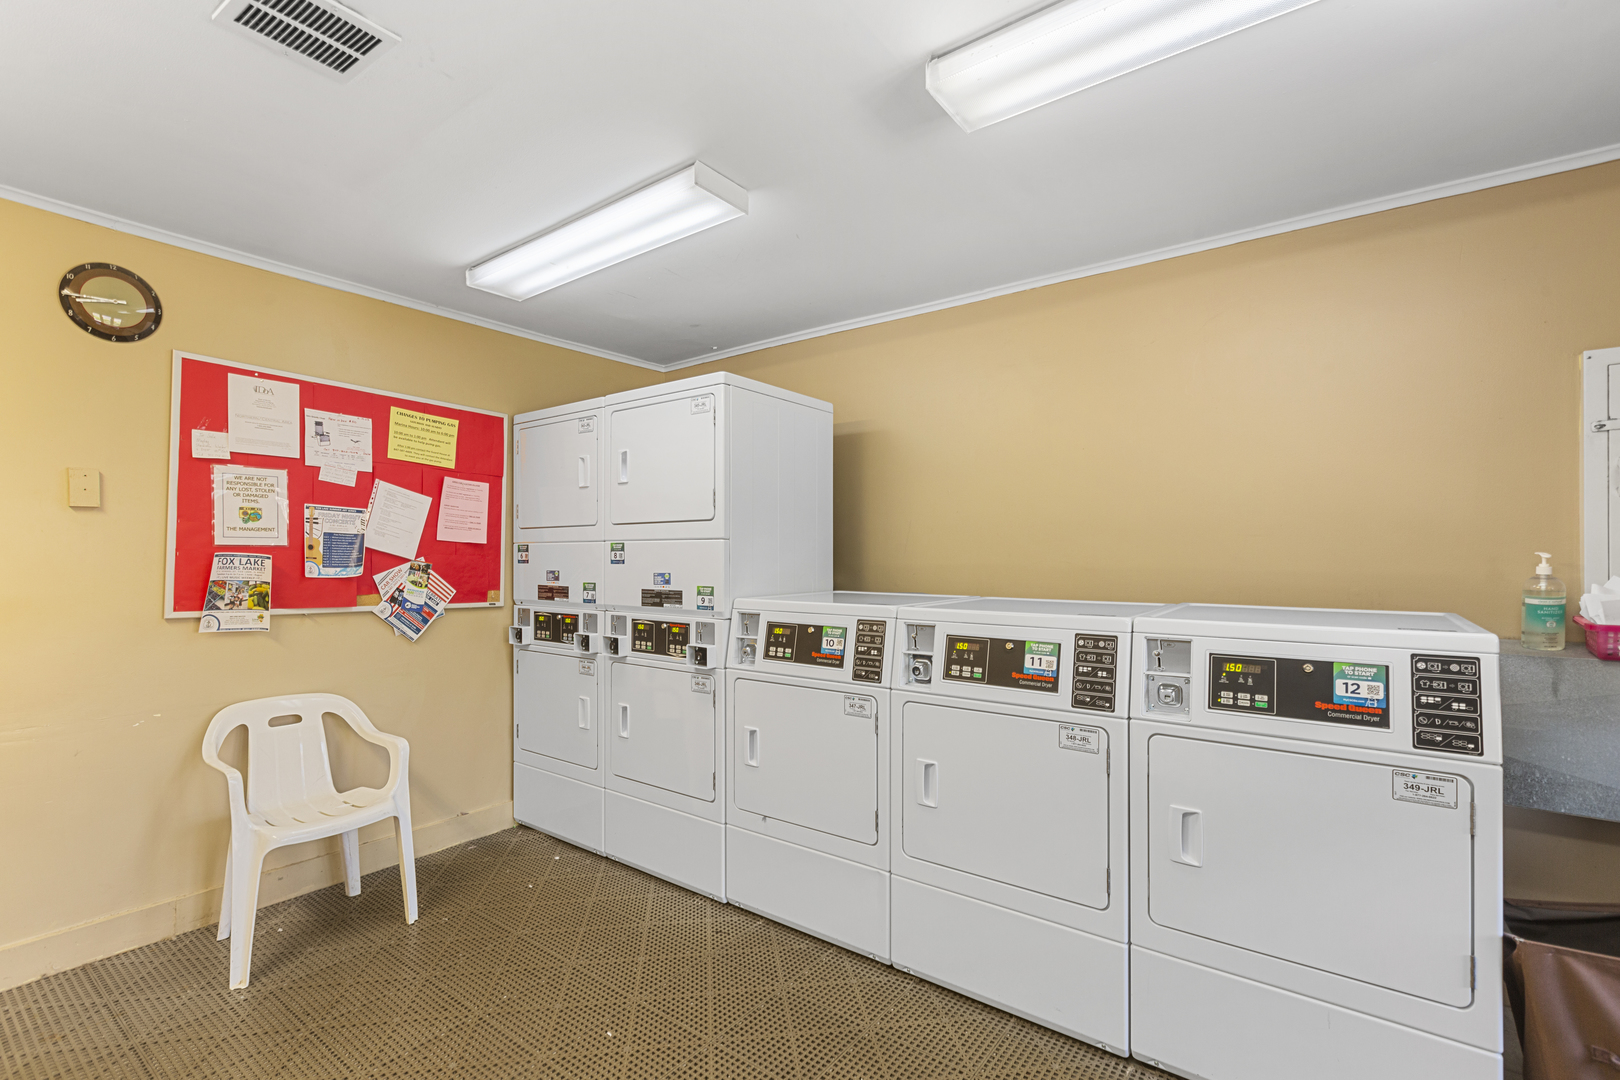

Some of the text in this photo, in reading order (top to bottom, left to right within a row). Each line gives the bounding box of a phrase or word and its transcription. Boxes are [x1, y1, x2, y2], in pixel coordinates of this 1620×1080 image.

[226, 480, 263, 488] RESPONSIBLE
[217, 557, 235, 566] FOX
[239, 558, 266, 567] LAKE
[381, 581, 390, 591] CAR
[388, 568, 403, 582] SHOW
[825, 639, 835, 647] 10
[1030, 656, 1042, 667] 11
[1033, 674, 1054, 682] Queen
[1342, 682, 1361, 695] 12
[1314, 701, 1382, 714] Speed Queen
[1327, 711, 1362, 720] Commercial
[1065, 734, 1092, 744] 348-JRL
[1403, 783, 1445, 795] 349-JRL
